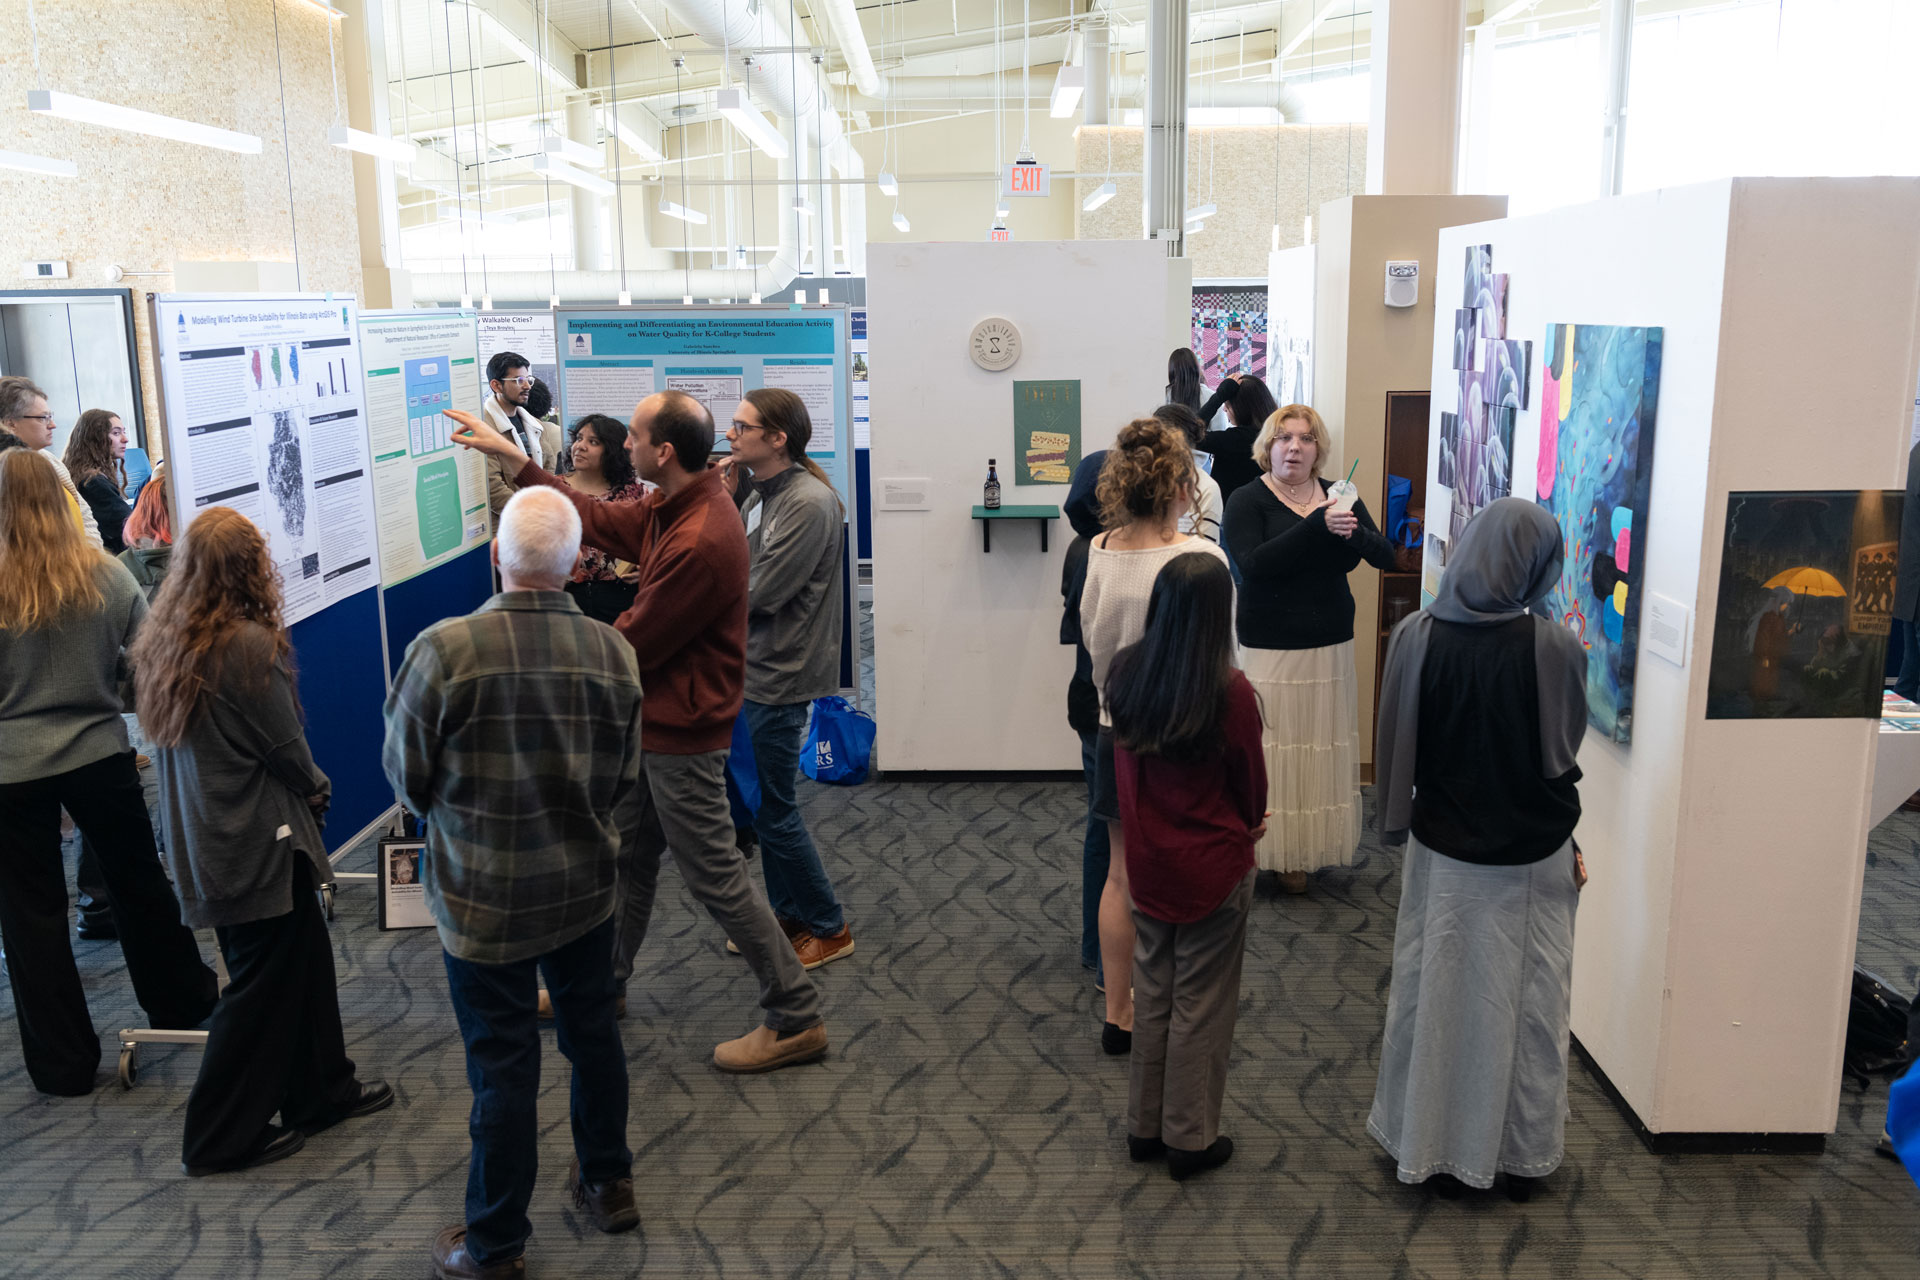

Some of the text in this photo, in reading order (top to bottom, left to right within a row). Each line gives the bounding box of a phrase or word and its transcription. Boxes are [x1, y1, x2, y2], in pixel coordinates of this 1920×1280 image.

[1011, 167, 1043, 191] EXIT
[991, 231, 1010, 241] EXIT
[191, 315, 217, 326] Modelling
[218, 314, 230, 323] Wind
[231, 313, 248, 323] Turbine
[249, 313, 258, 322] Site
[258, 312, 279, 322] Suitability
[569, 321, 622, 329] Implementing
[640, 321, 696, 329] Differentiating
[708, 320, 764, 328] Environmental
[765, 320, 802, 328] Education
[805, 320, 833, 329] Activity
[662, 331, 690, 339] Quality
[705, 330, 742, 338] K-College
